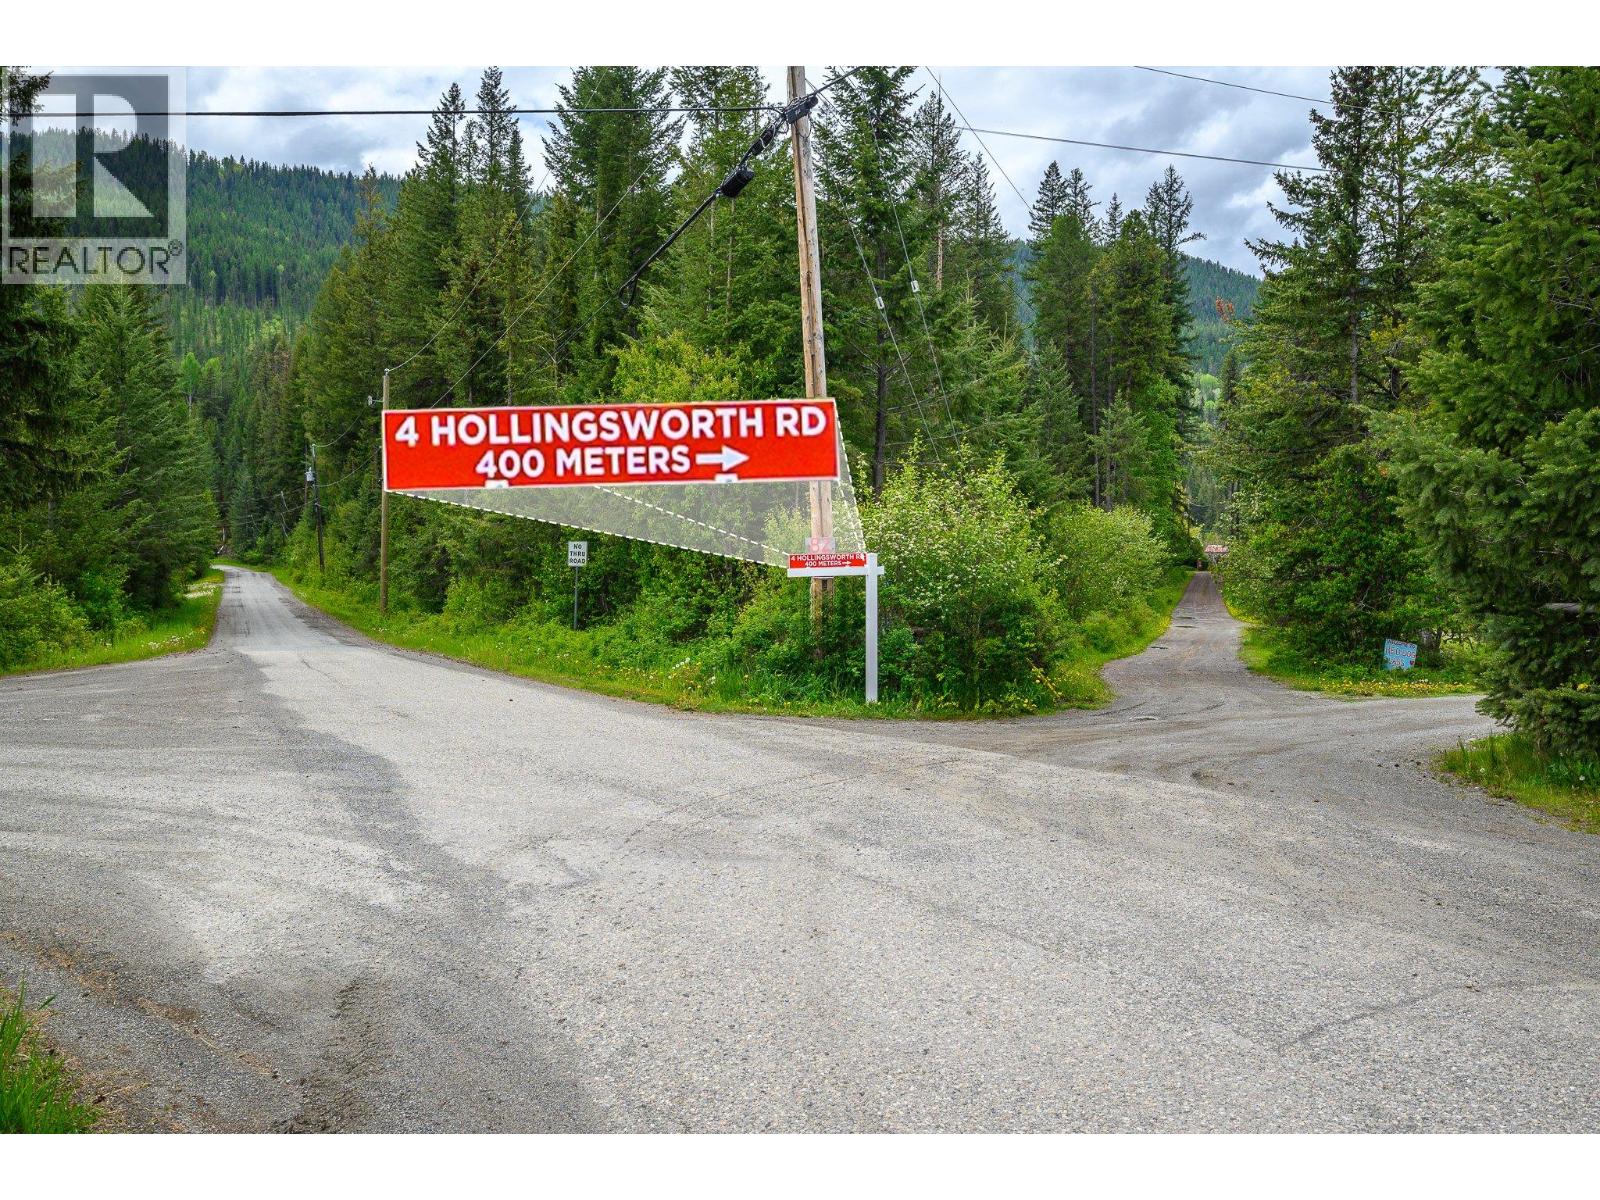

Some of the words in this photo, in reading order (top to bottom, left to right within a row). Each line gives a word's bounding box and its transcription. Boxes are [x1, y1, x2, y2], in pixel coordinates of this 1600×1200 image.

[395, 416, 419, 446] 4
[432, 408, 763, 446] HOLLINGSWORTH
[776, 406, 826, 437] RD
[476, 449, 545, 477] 400
[556, 446, 691, 476] METERS
